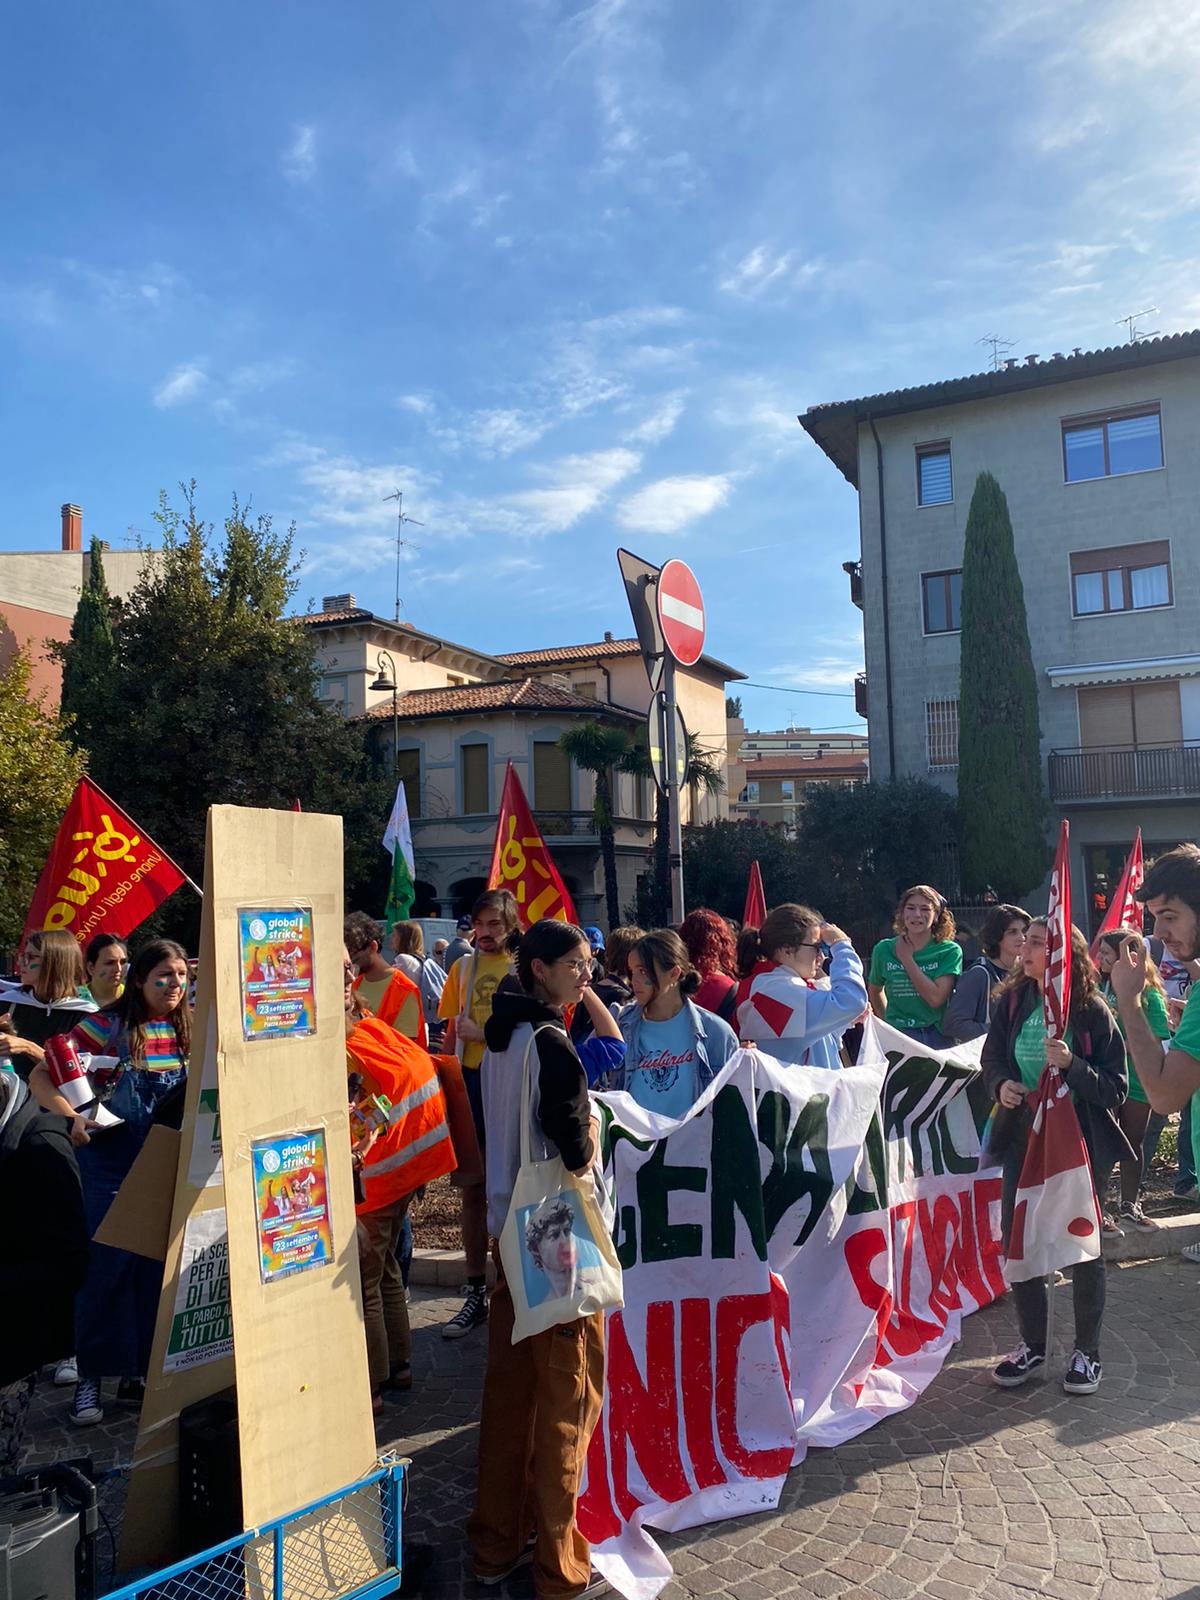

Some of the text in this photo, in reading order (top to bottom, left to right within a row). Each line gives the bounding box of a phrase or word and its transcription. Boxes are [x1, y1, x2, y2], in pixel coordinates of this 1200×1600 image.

[268, 918, 299, 930] global
[259, 1003, 303, 1015] 23 settembre
[281, 1142, 311, 1159] global
[192, 1242, 228, 1263] LA SCE
[276, 1241, 287, 1252] 23
[286, 1233, 319, 1248] settembre
[190, 1258, 229, 1284] PER IL
[185, 1277, 230, 1309] DI VE
[182, 1314, 189, 1328] IL
[192, 1305, 221, 1325] PARCO
[180, 1318, 224, 1349] TUTTO
[181, 1356, 195, 1365] NON
[195, 1353, 203, 1361] LO
